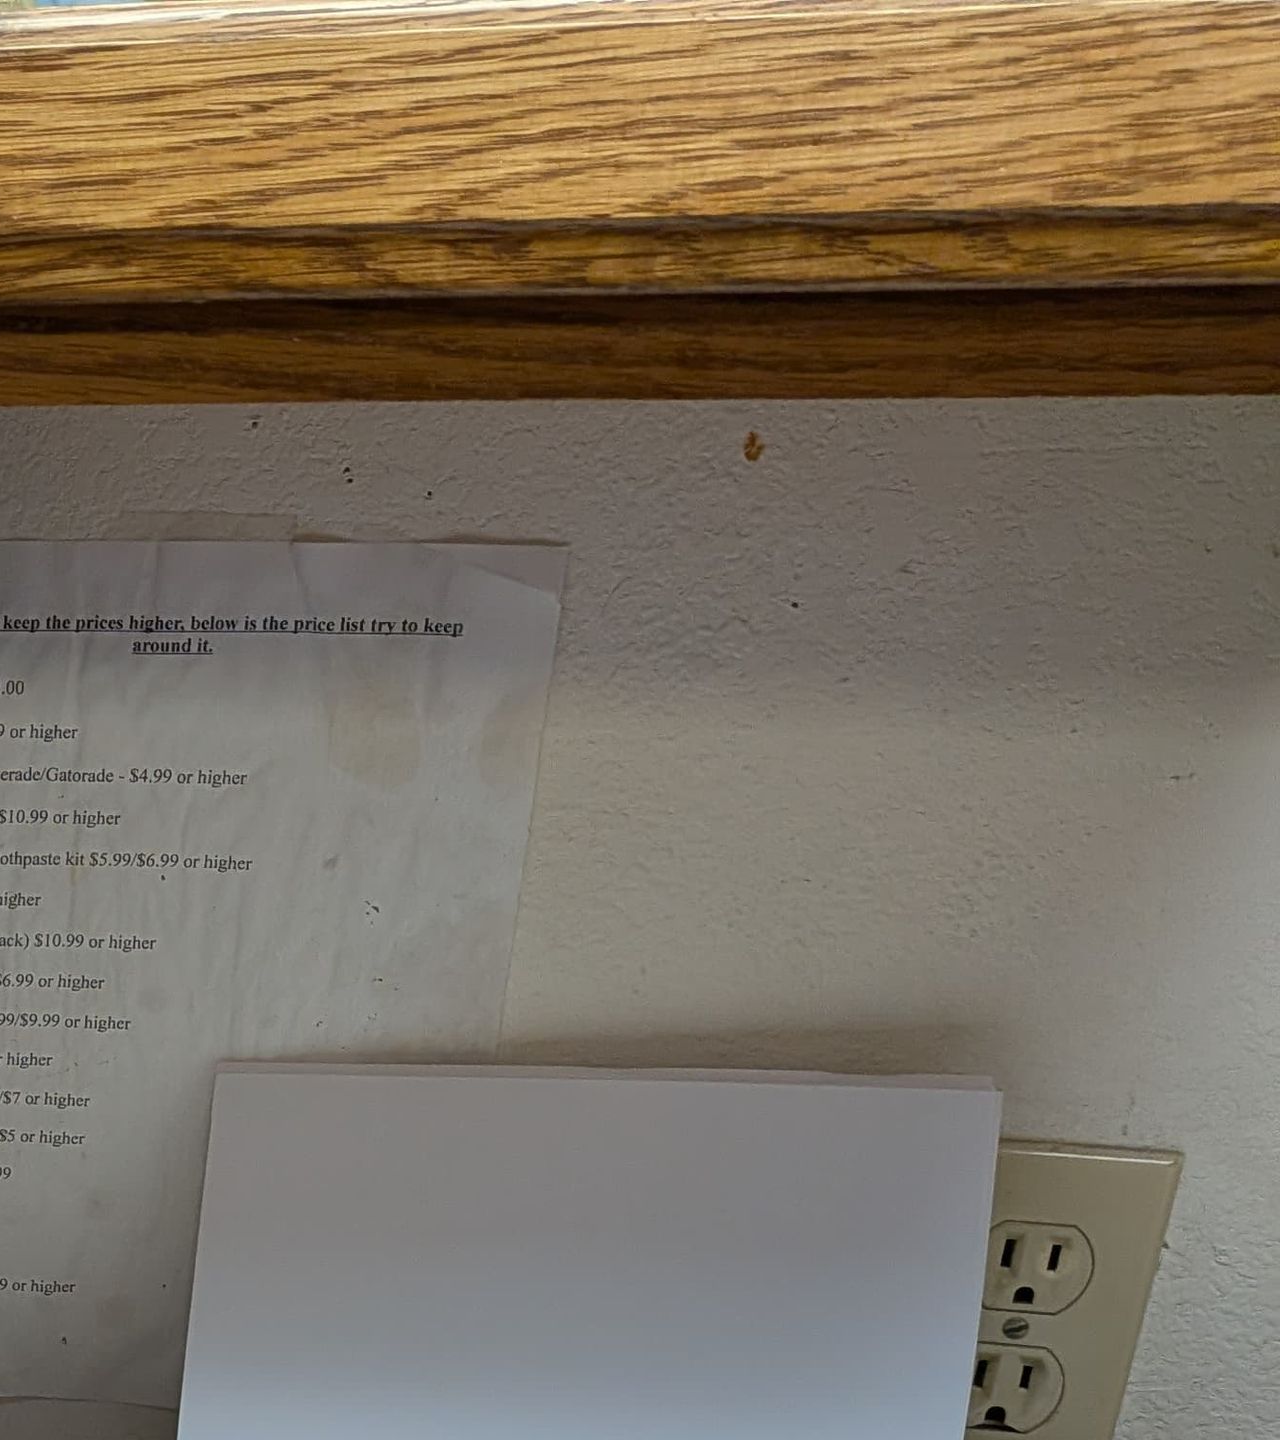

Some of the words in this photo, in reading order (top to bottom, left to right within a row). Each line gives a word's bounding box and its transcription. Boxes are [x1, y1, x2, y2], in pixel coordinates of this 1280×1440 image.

[3, 614, 40, 634] keep
[45, 615, 70, 630] the
[75, 615, 125, 633] prices
[129, 615, 185, 633] higher,
[191, 616, 239, 632] below
[244, 616, 258, 632] is
[263, 616, 289, 632] the
[293, 617, 335, 635] price
[340, 617, 366, 632] list
[371, 619, 397, 636] try
[401, 619, 419, 634] to
[423, 618, 464, 637] keep
[132, 638, 192, 654] around
[197, 638, 214, 654] it.
[129, 767, 173, 784] $4.99
[177, 772, 193, 784] or
[197, 769, 248, 788] higher
[65, 851, 86, 866] kit
[89, 851, 179, 869] $5.99/$6.99
[183, 856, 200, 869] or
[203, 854, 253, 873] higher
[34, 932, 85, 950] $10.99
[88, 936, 106, 949] or
[108, 934, 157, 953] higher
